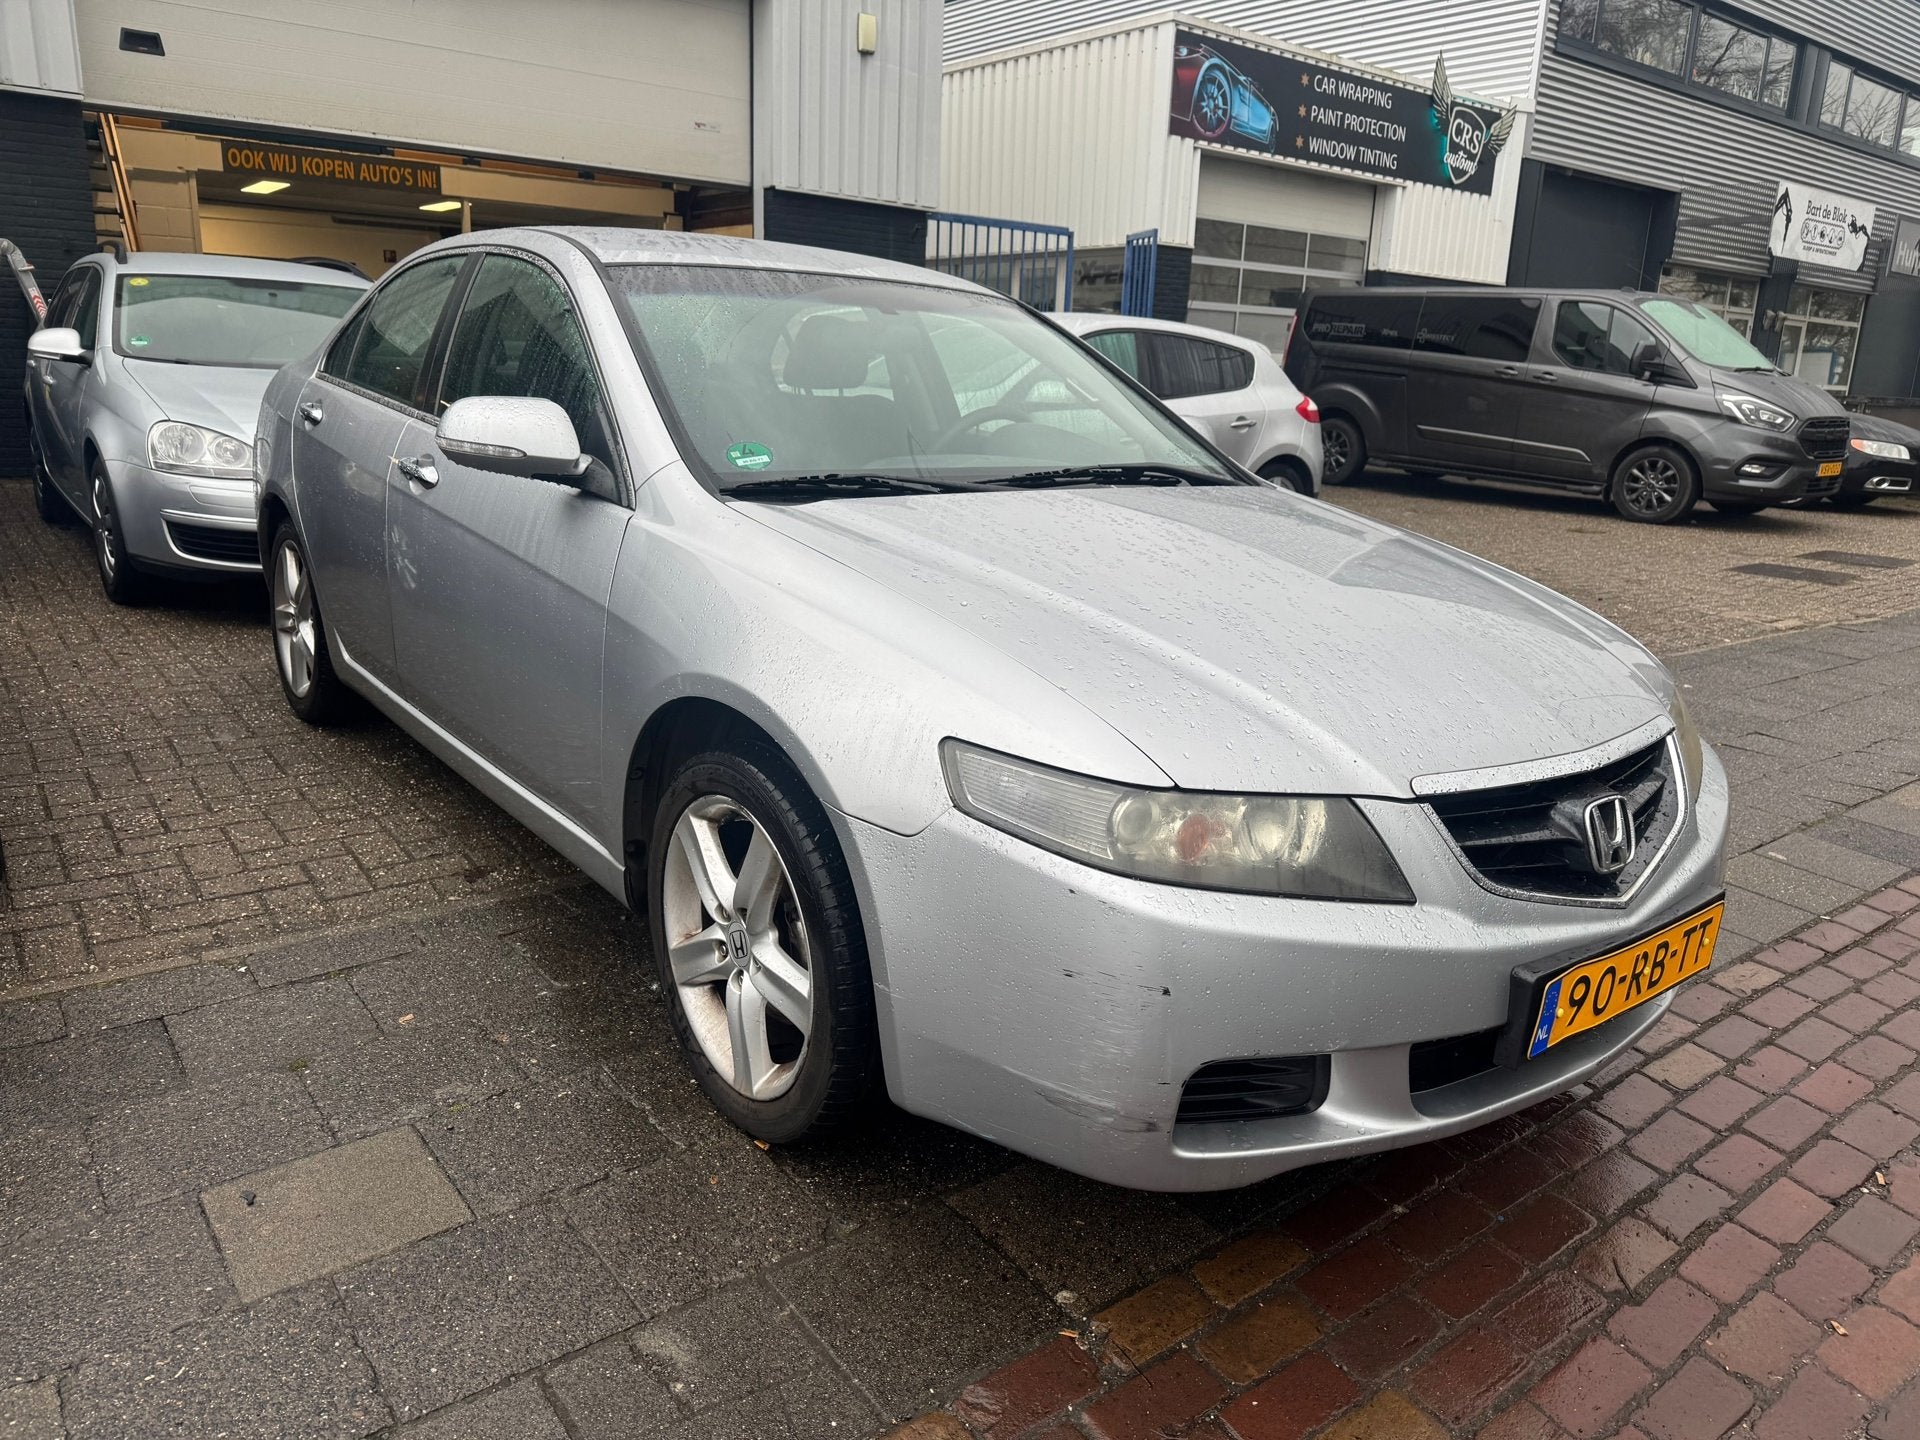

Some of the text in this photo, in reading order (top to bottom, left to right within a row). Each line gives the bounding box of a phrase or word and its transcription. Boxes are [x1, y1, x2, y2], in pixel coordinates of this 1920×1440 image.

[1313, 74, 1393, 110] CAR WRAPPING
[1310, 105, 1407, 143] PAINT PROTECTION
[1452, 118, 1481, 154] CRS
[227, 147, 438, 189] OOK WIJ KOPEN AUTO'S IN!
[1308, 136, 1398, 170] WINDOW TINTING
[1443, 150, 1478, 175] customs
[1805, 199, 1847, 224] Bart de Blok
[1566, 917, 1714, 1028] 90-RB-TT
[1535, 1026, 1549, 1043] NL
